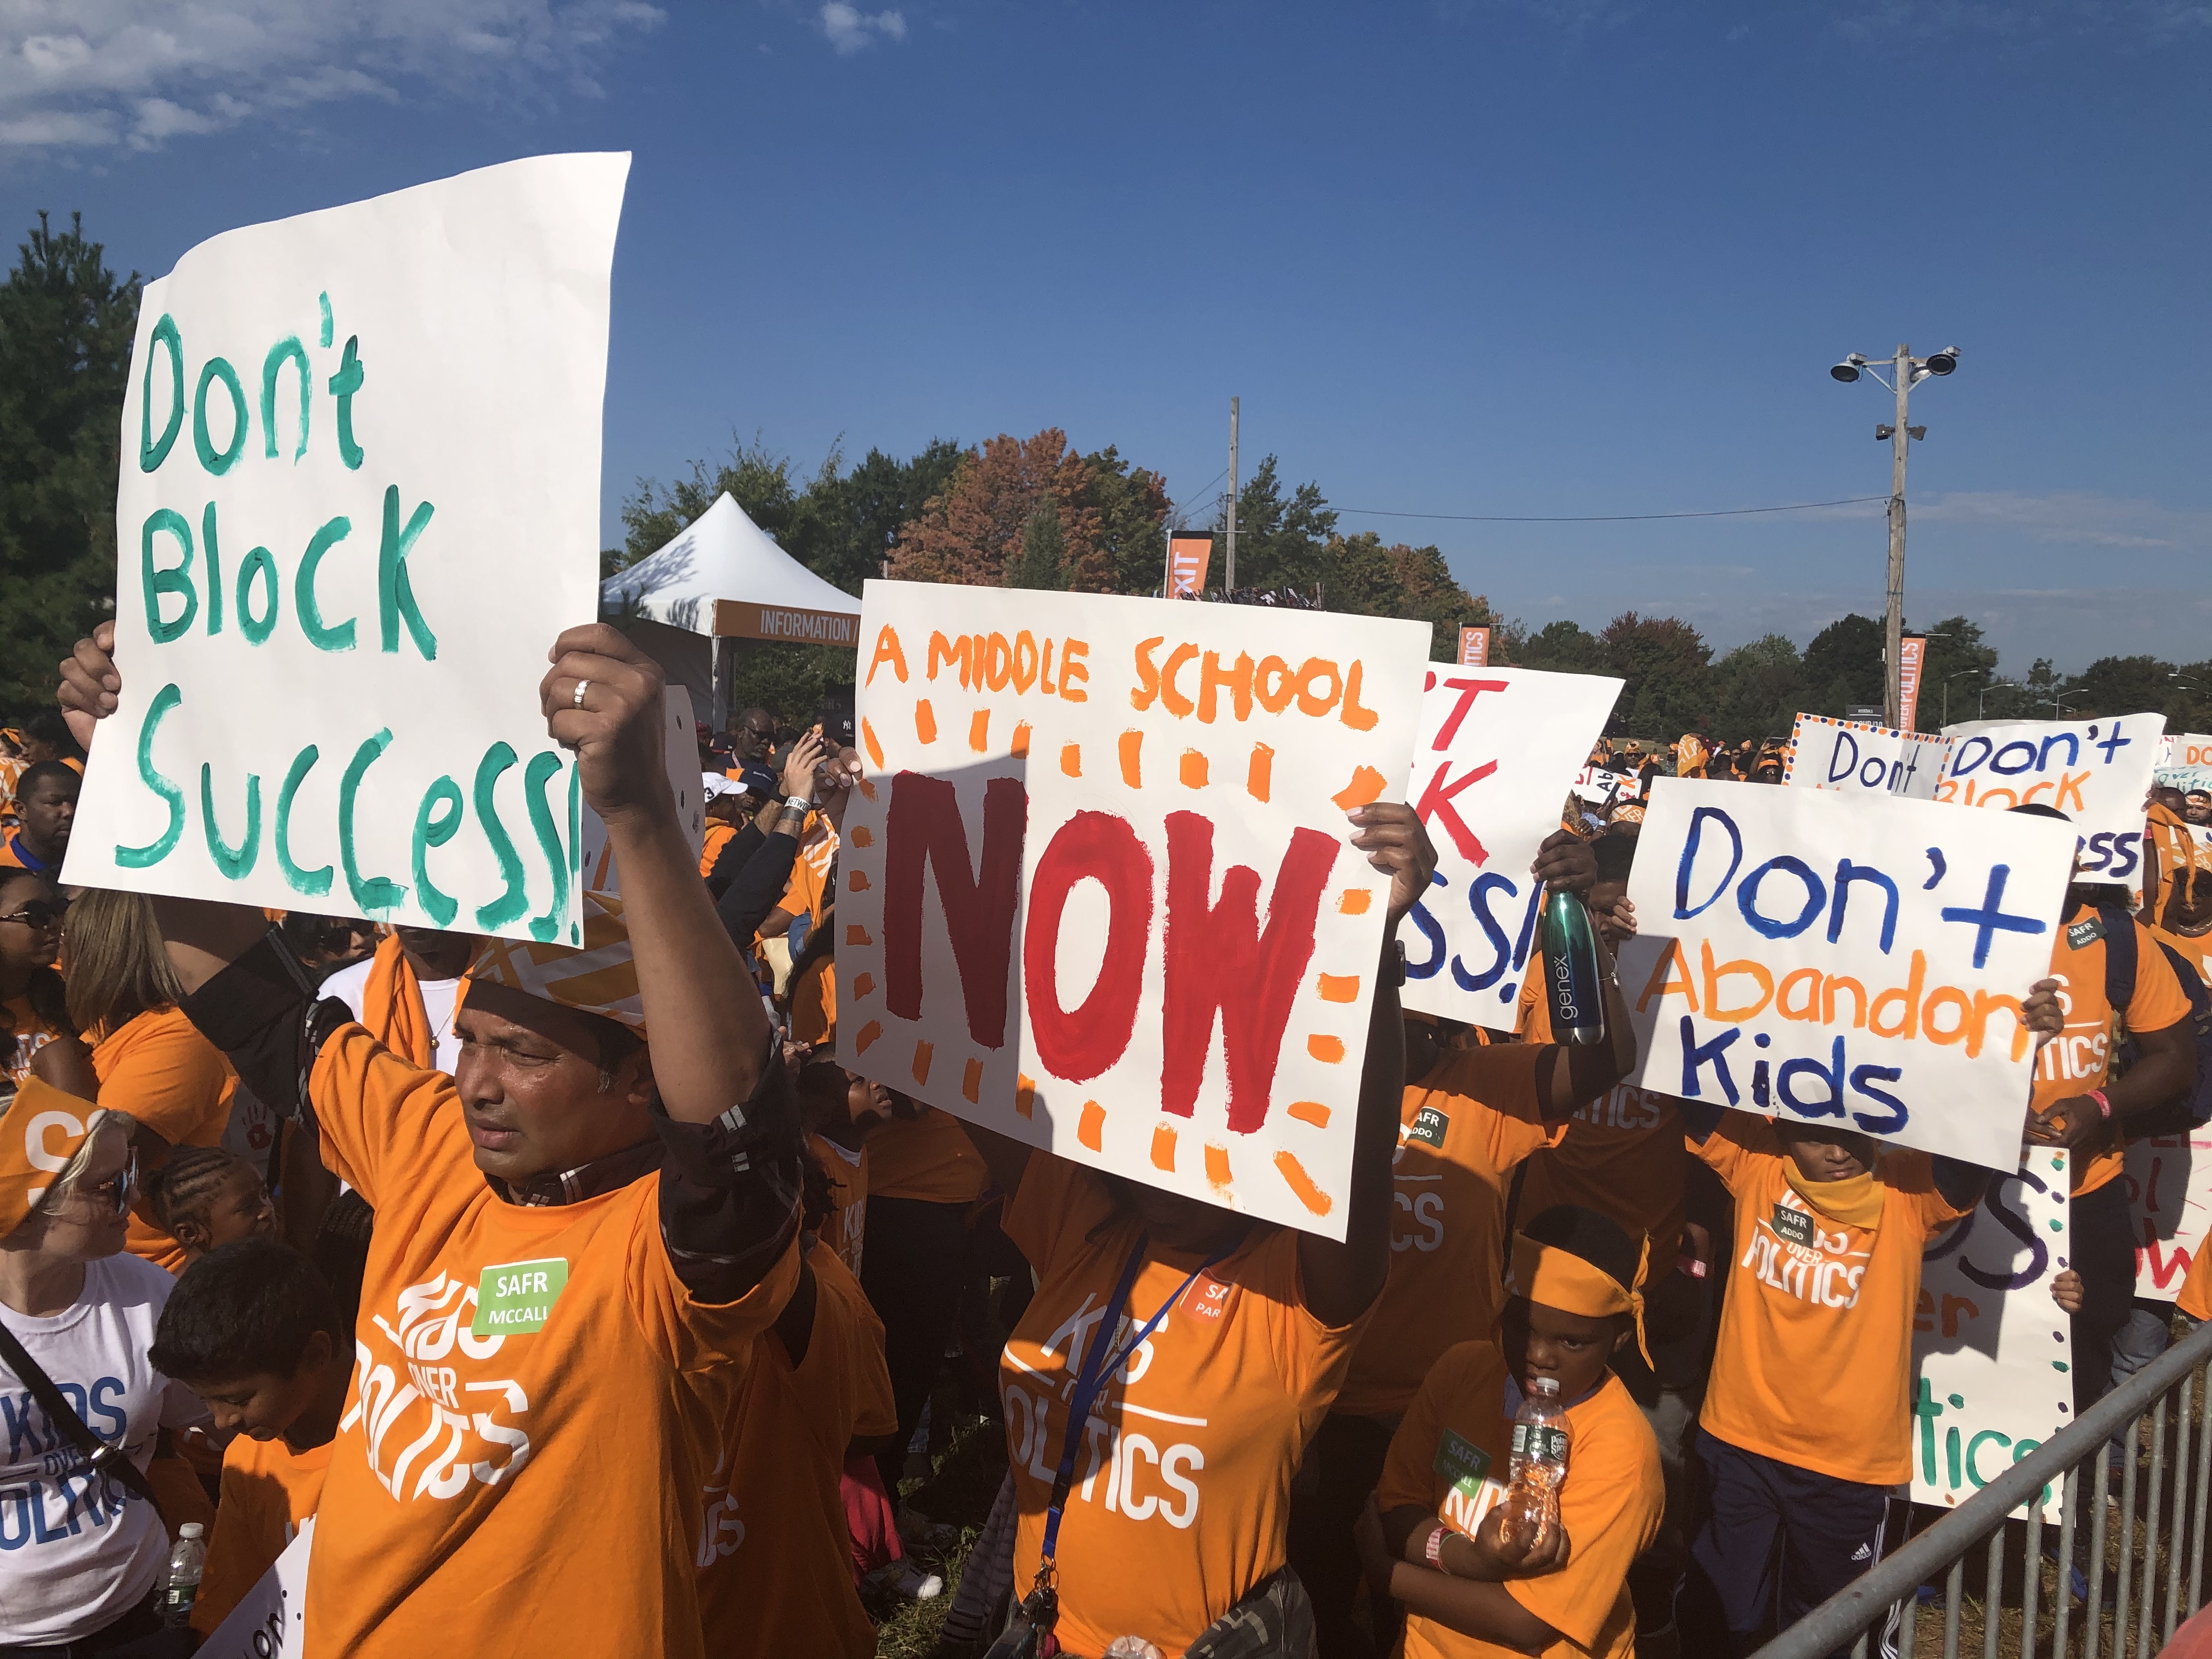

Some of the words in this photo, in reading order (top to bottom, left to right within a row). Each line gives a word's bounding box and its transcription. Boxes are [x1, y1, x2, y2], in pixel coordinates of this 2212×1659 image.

[140, 290, 364, 476] Don't
[1174, 551, 1199, 600] XIT
[760, 610, 850, 641] INFORMATION
[866, 624, 909, 688] A
[927, 629, 1090, 703] MIDDLE
[1131, 636, 1379, 732] SCHOOL
[1950, 721, 2131, 777] Don't
[1672, 806, 2047, 969] Don't
[884, 770, 1341, 1135] NOW
[2068, 922, 2094, 937] SAFR
[2076, 932, 2097, 945] ADDO
[1554, 952, 1578, 1020] genex
[1635, 938, 2035, 1063] Abandon
[1680, 1015, 1909, 1135] Kids
[1780, 1210, 1807, 1229] SAFR
[1780, 1226, 1804, 1240] ADDO
[496, 1272, 549, 1298] SAFR
[408, 1361, 460, 1409] OVER
[1448, 1440, 1481, 1471] SAFR
